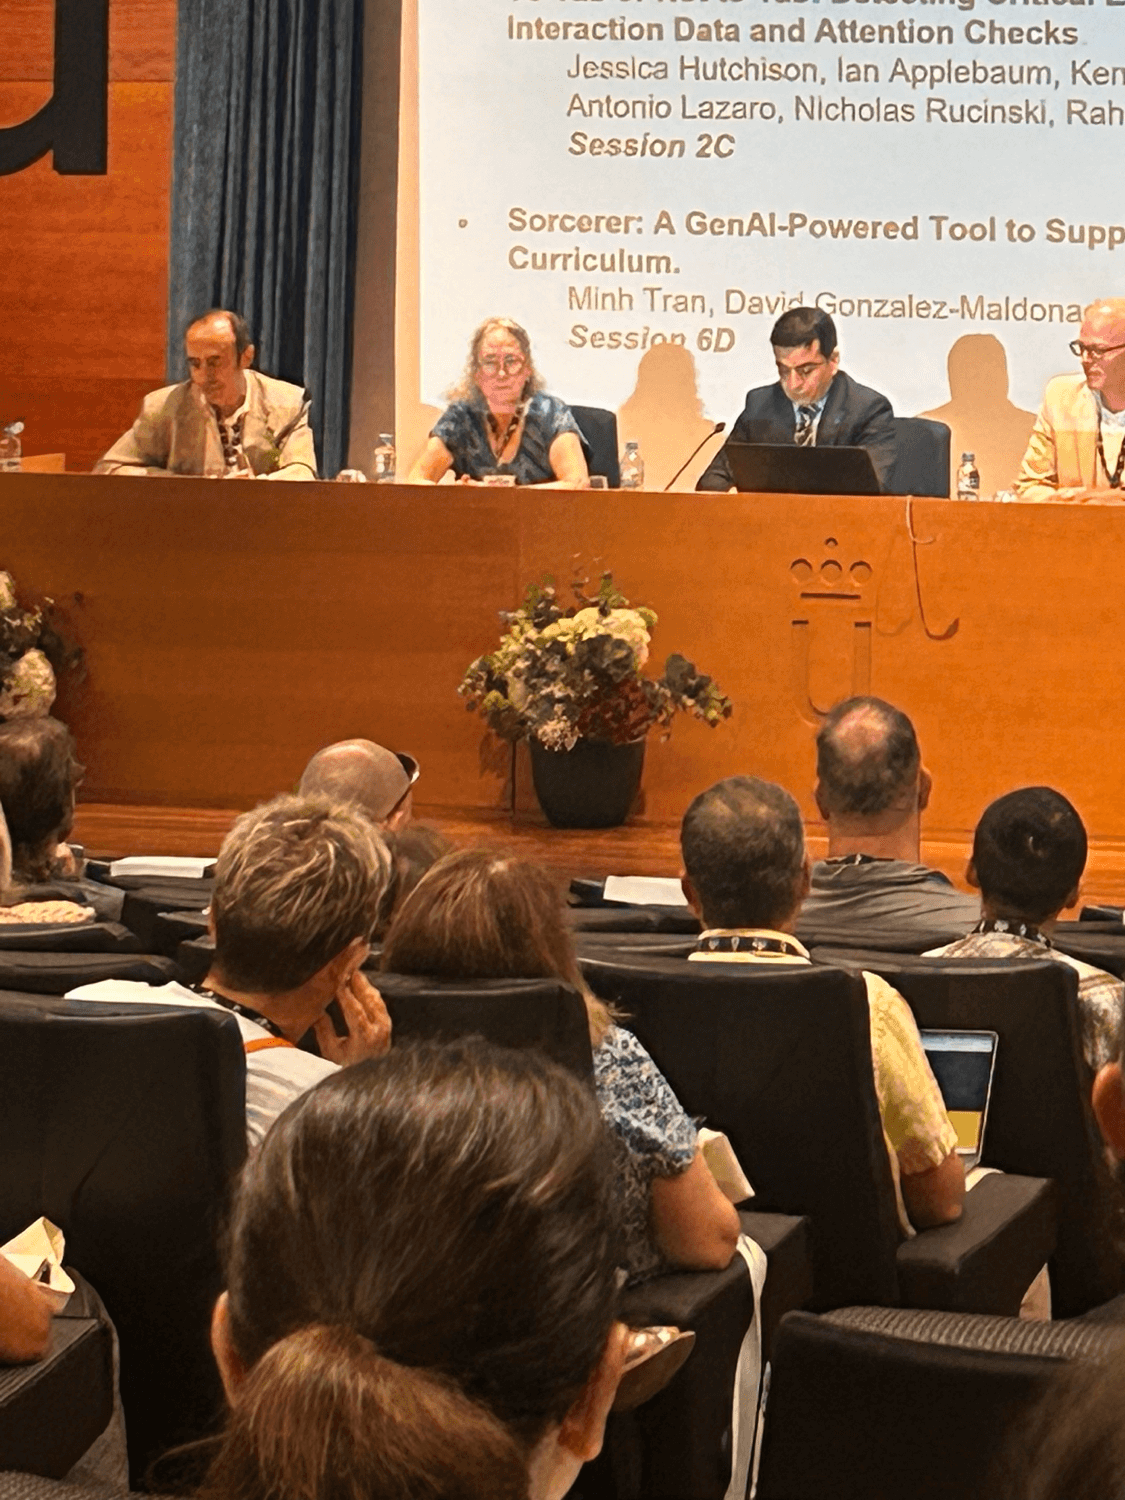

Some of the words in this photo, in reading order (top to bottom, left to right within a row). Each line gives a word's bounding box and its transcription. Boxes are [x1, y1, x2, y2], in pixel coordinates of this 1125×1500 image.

[508, 15, 663, 41] Interaction
[674, 17, 740, 42] Data
[750, 17, 805, 43] and
[814, 18, 953, 45] Attention
[567, 54, 668, 80] Jessica
[680, 55, 826, 85] Hutchison,
[838, 56, 879, 83] Ian
[888, 58, 1059, 90] Applebaum,
[567, 93, 672, 119] Antonio
[681, 94, 783, 124] Lazaro,
[795, 95, 915, 122] Nicholas
[926, 97, 1054, 128] Rucinski,
[568, 131, 685, 158] Session
[696, 133, 735, 158] 2C
[508, 207, 642, 234] Sorcerer:
[654, 210, 676, 235] A
[685, 211, 918, 240] GenAI-Powered
[929, 216, 996, 241] Tool
[1005, 219, 1035, 242] to
[509, 245, 680, 274] Curriculum.
[569, 286, 633, 311] Minh
[643, 287, 713, 317] Tran,
[814, 292, 1088, 324] Gonzalez-Maldona
[569, 324, 686, 350] Session
[697, 327, 735, 352] 6D
